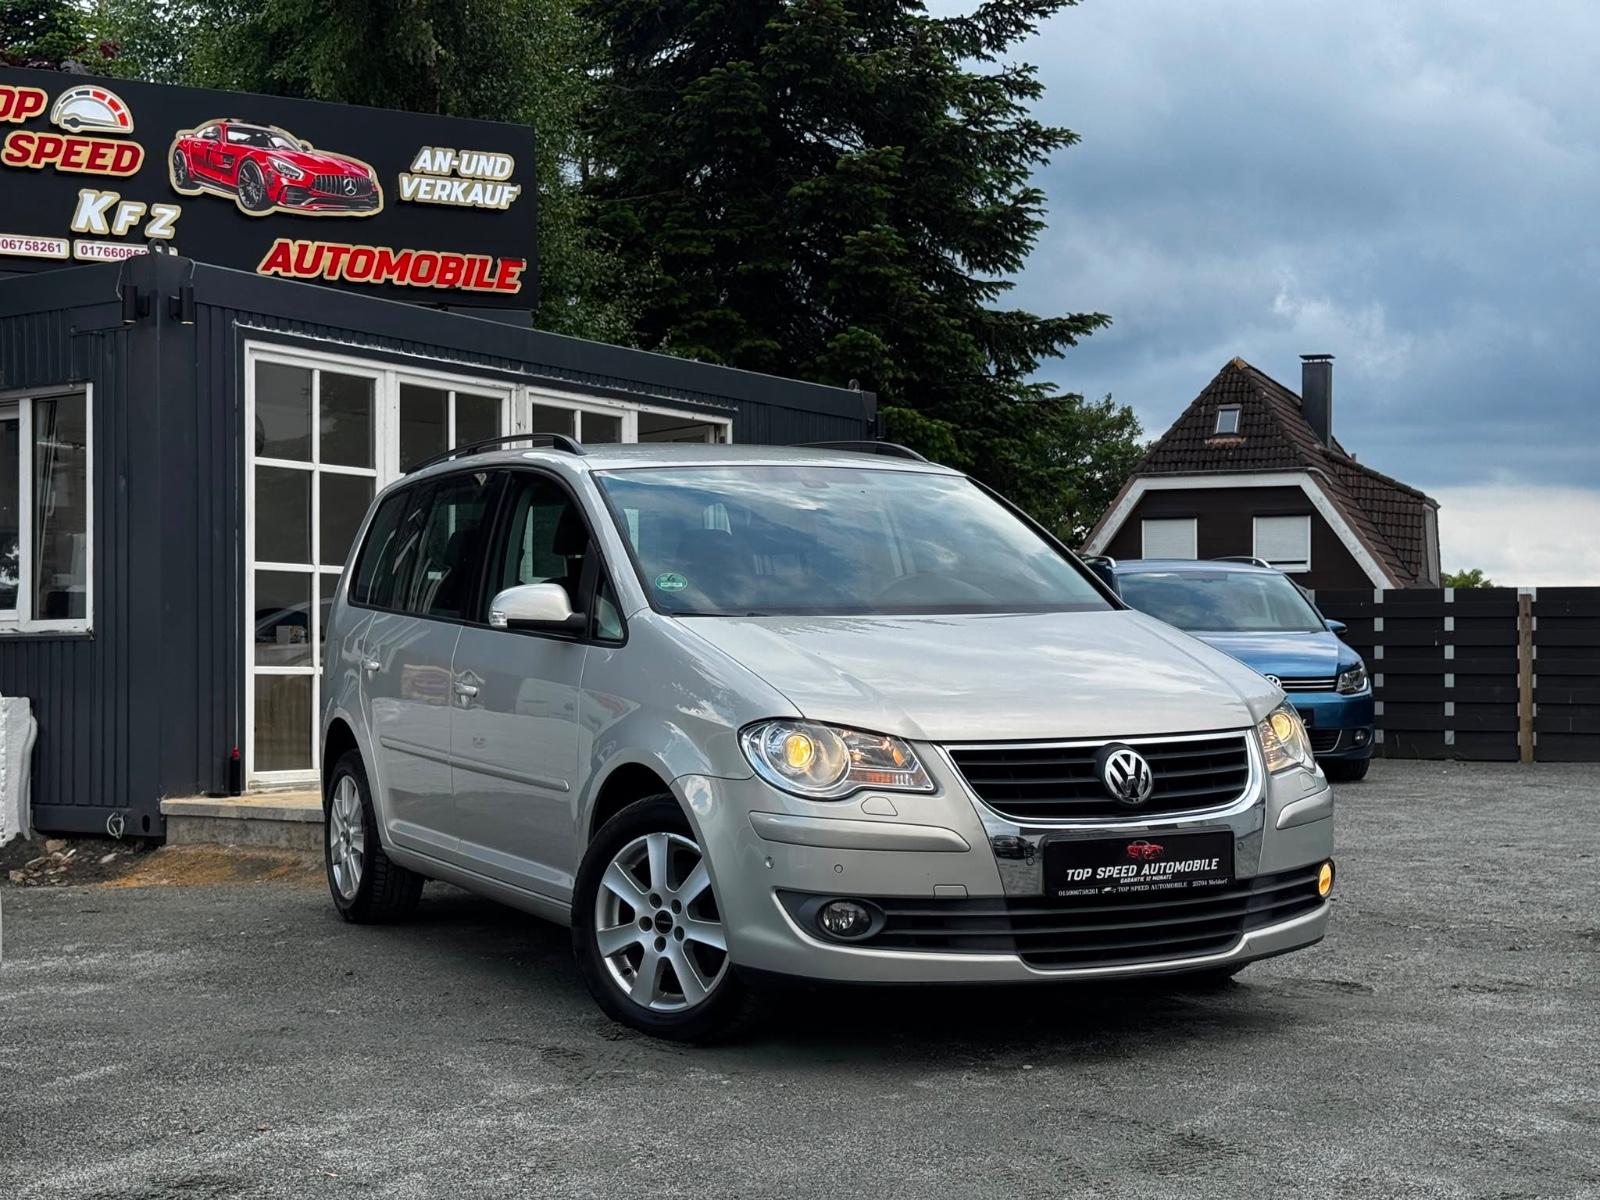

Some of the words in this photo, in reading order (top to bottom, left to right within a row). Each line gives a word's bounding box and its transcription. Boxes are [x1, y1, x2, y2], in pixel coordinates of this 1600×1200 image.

[4, 133, 142, 173] SPEED
[413, 149, 512, 178] AN-UND
[401, 175, 519, 207] VERKAUF
[261, 241, 526, 291] AUTOMOBILE
[1066, 868, 1092, 881] TOP
[1096, 864, 1137, 879] SPEED
[1141, 857, 1220, 876] AUTOMOBILE
[1151, 881, 1188, 890] AUTOMOBILE
